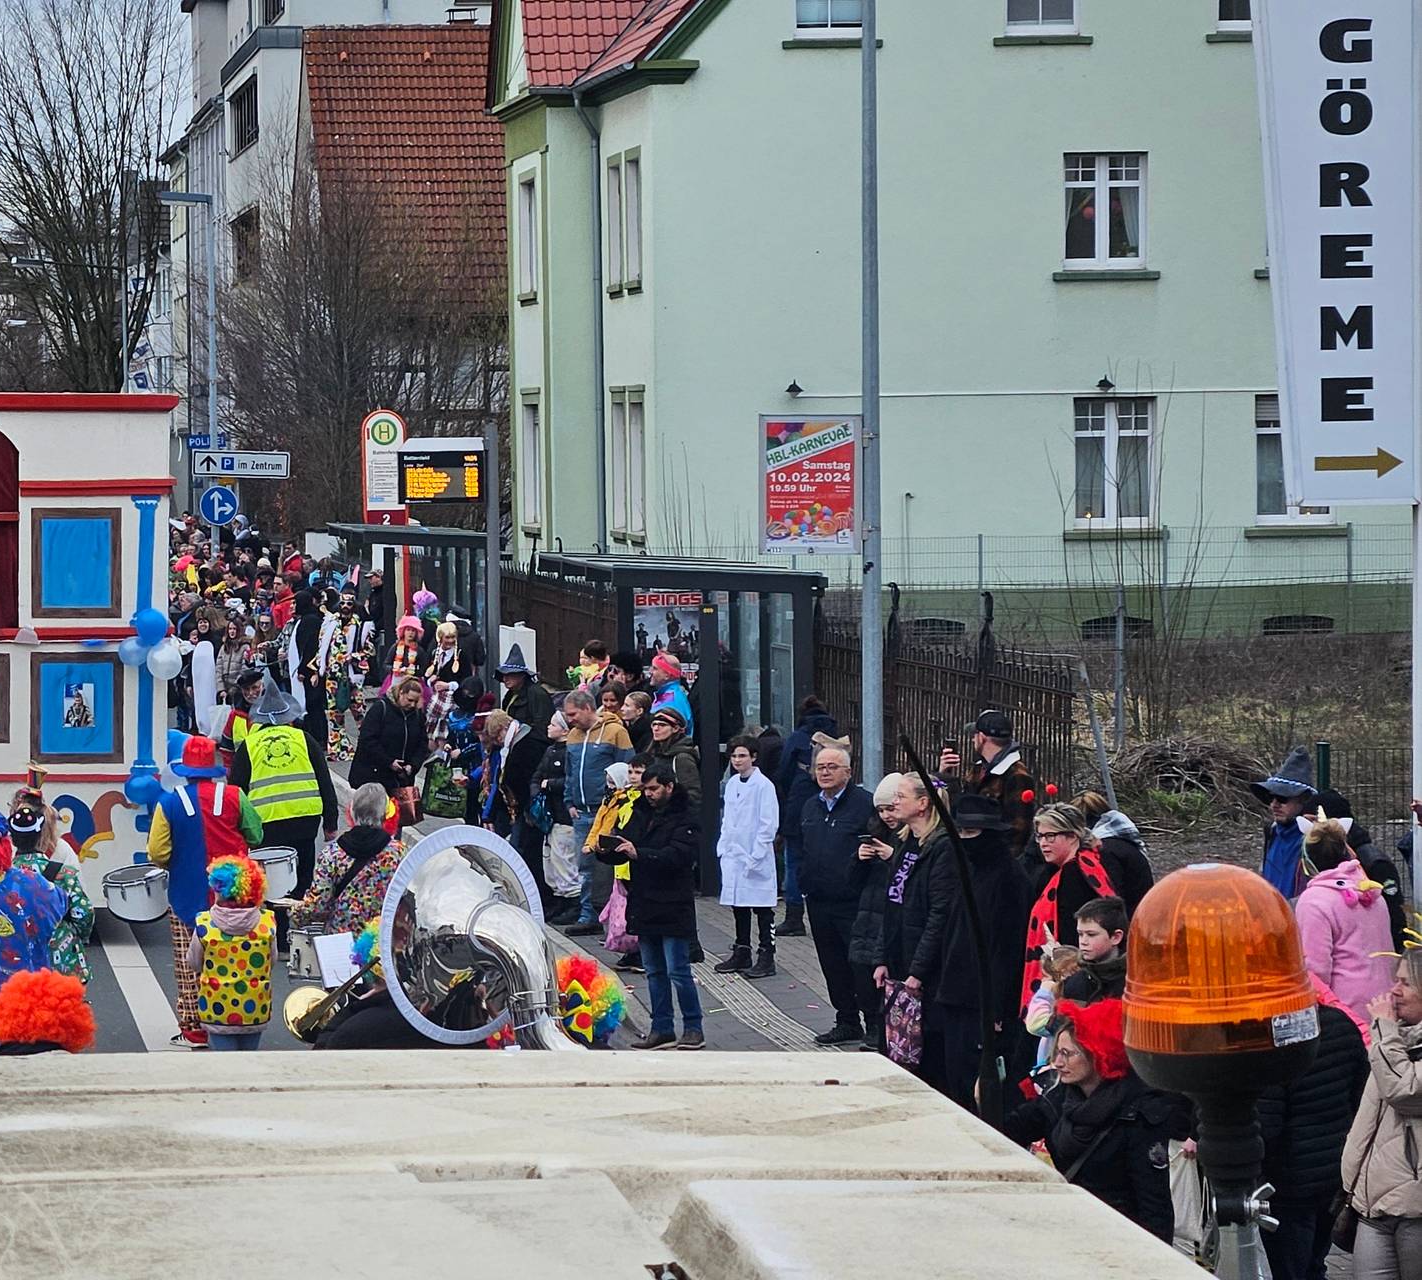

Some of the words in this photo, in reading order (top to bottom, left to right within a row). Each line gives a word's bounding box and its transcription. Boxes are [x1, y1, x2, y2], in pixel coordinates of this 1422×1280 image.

[1319, 18, 1374, 422] GÖREME
[189, 436, 225, 447] POLIEI
[766, 423, 853, 466] HBL-KARNEVAL
[238, 461, 248, 470] im
[251, 460, 283, 471] Zentrum
[802, 460, 851, 471] Samstag
[769, 472, 851, 483] 10.02.2024
[769, 484, 797, 492] 19.59
[799, 484, 817, 492] Uhr
[382, 513, 391, 525] 2
[635, 592, 702, 607] BRINGS
